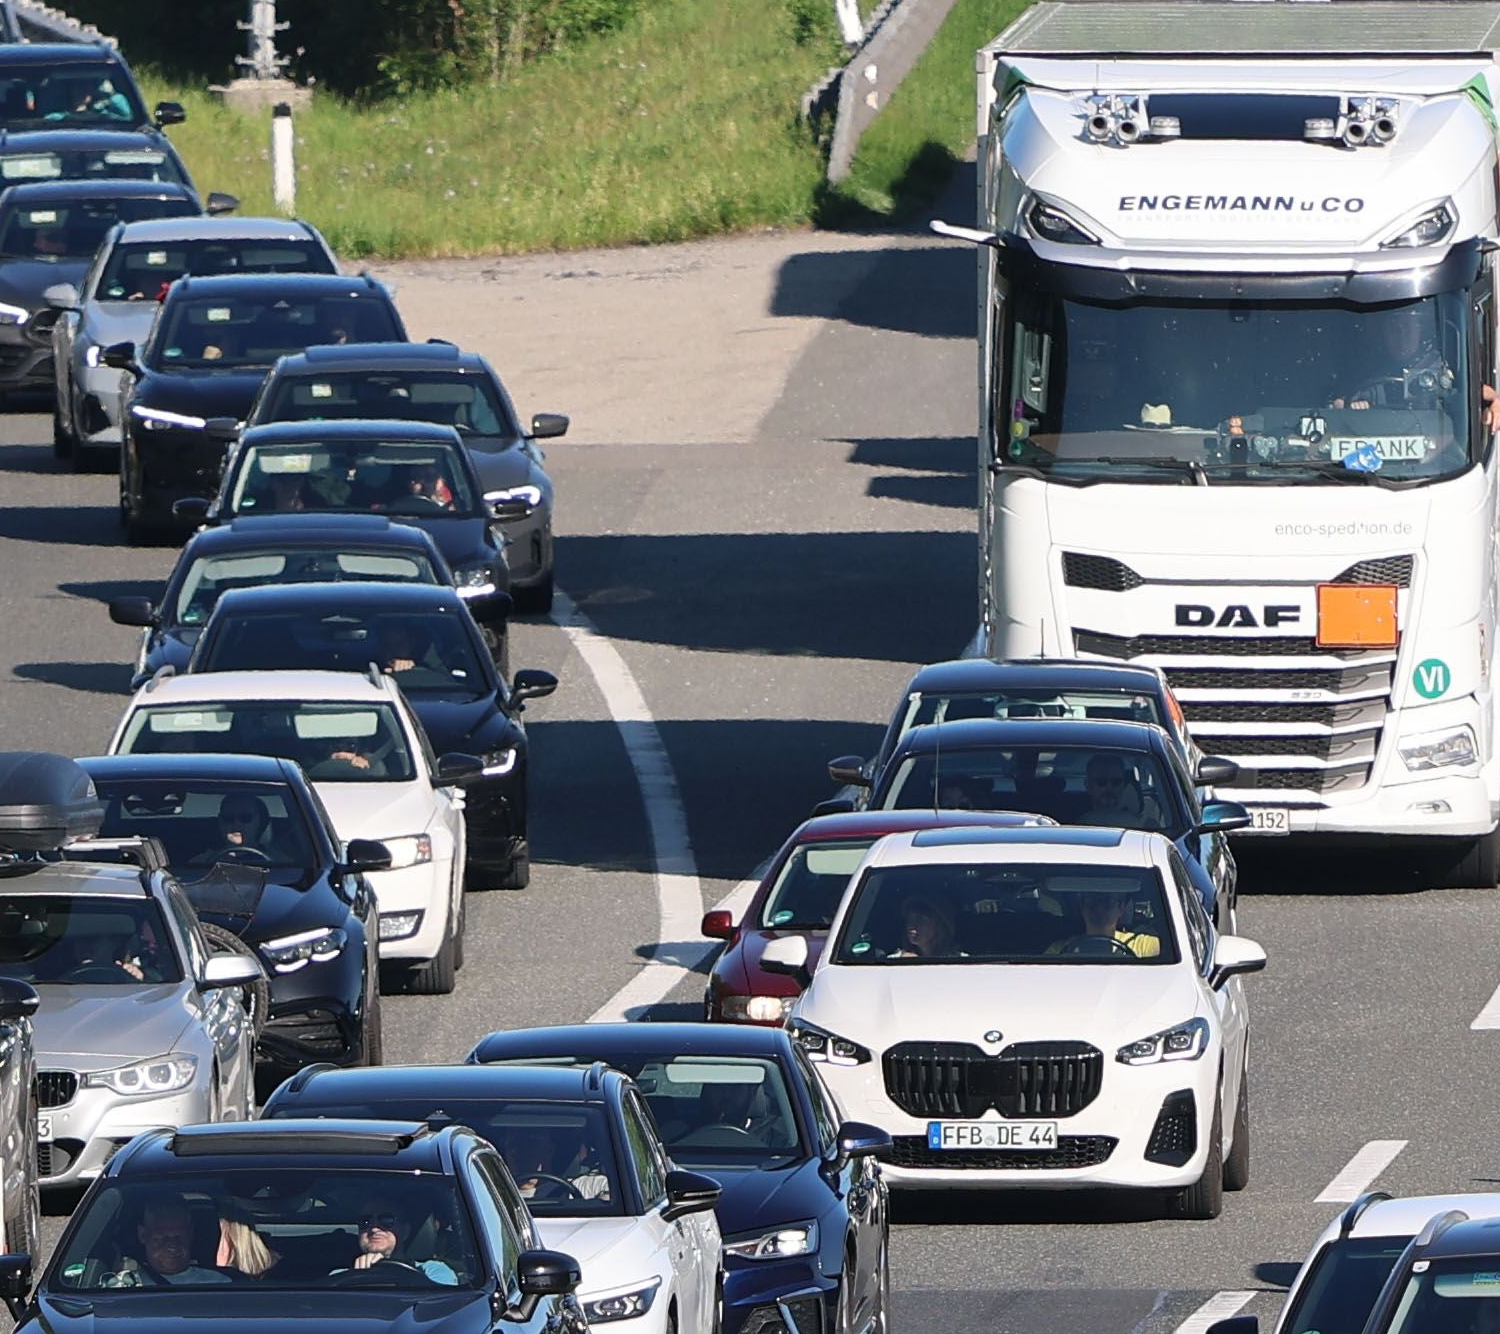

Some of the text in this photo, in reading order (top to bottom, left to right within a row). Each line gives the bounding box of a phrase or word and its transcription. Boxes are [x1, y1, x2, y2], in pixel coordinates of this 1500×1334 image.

[1118, 195, 1294, 211] ENGEMANN
[1321, 197, 1365, 213] CO
[1174, 603, 1301, 628] DAF
[1418, 665, 1444, 694] VI
[943, 1126, 983, 1145] FFB
[997, 1126, 1023, 1146] DE
[1029, 1126, 1054, 1145] 44
